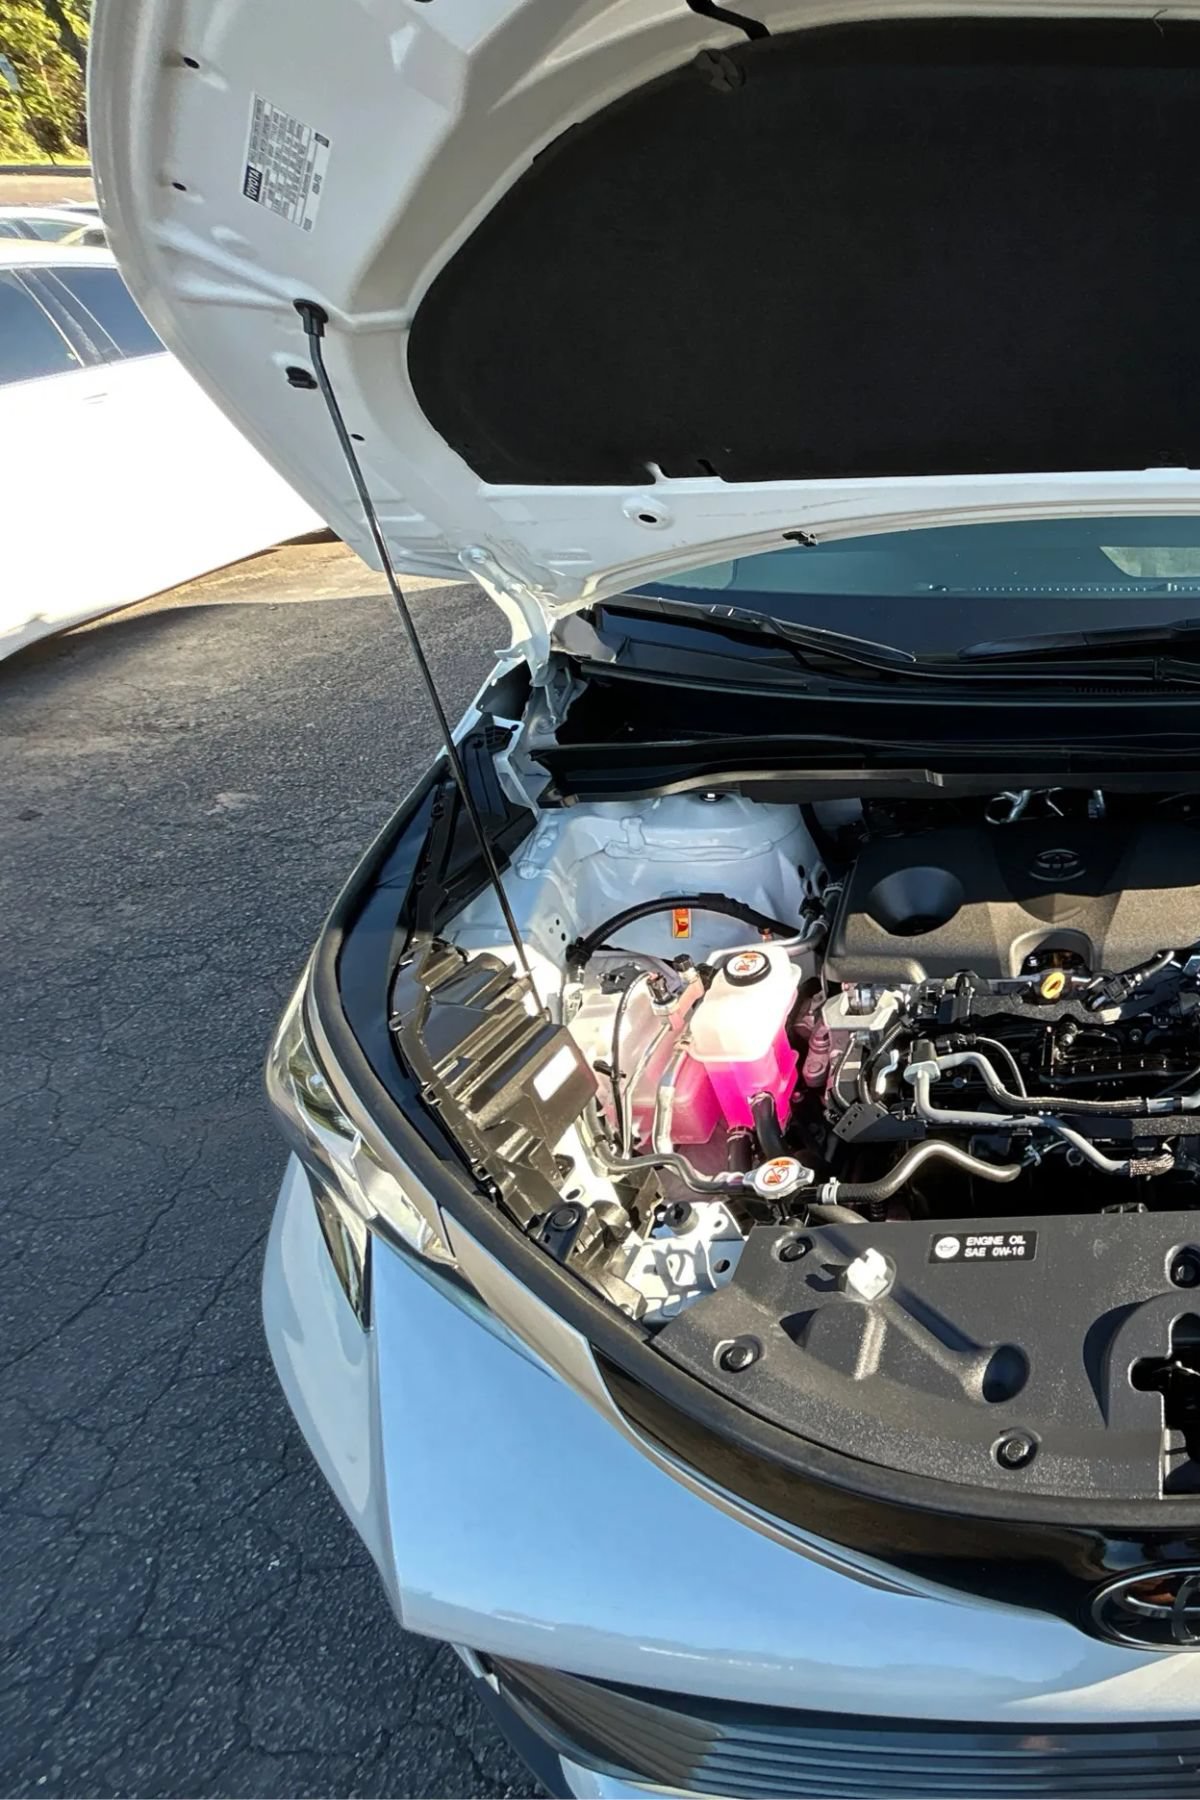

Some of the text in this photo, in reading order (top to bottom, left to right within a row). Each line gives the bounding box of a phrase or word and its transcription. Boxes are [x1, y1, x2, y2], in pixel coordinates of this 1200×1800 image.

[246, 168, 261, 201] TOYOTA
[966, 1235, 1026, 1246] ENGINE OIL
[964, 1246, 1025, 1257] SAE 0W-16
